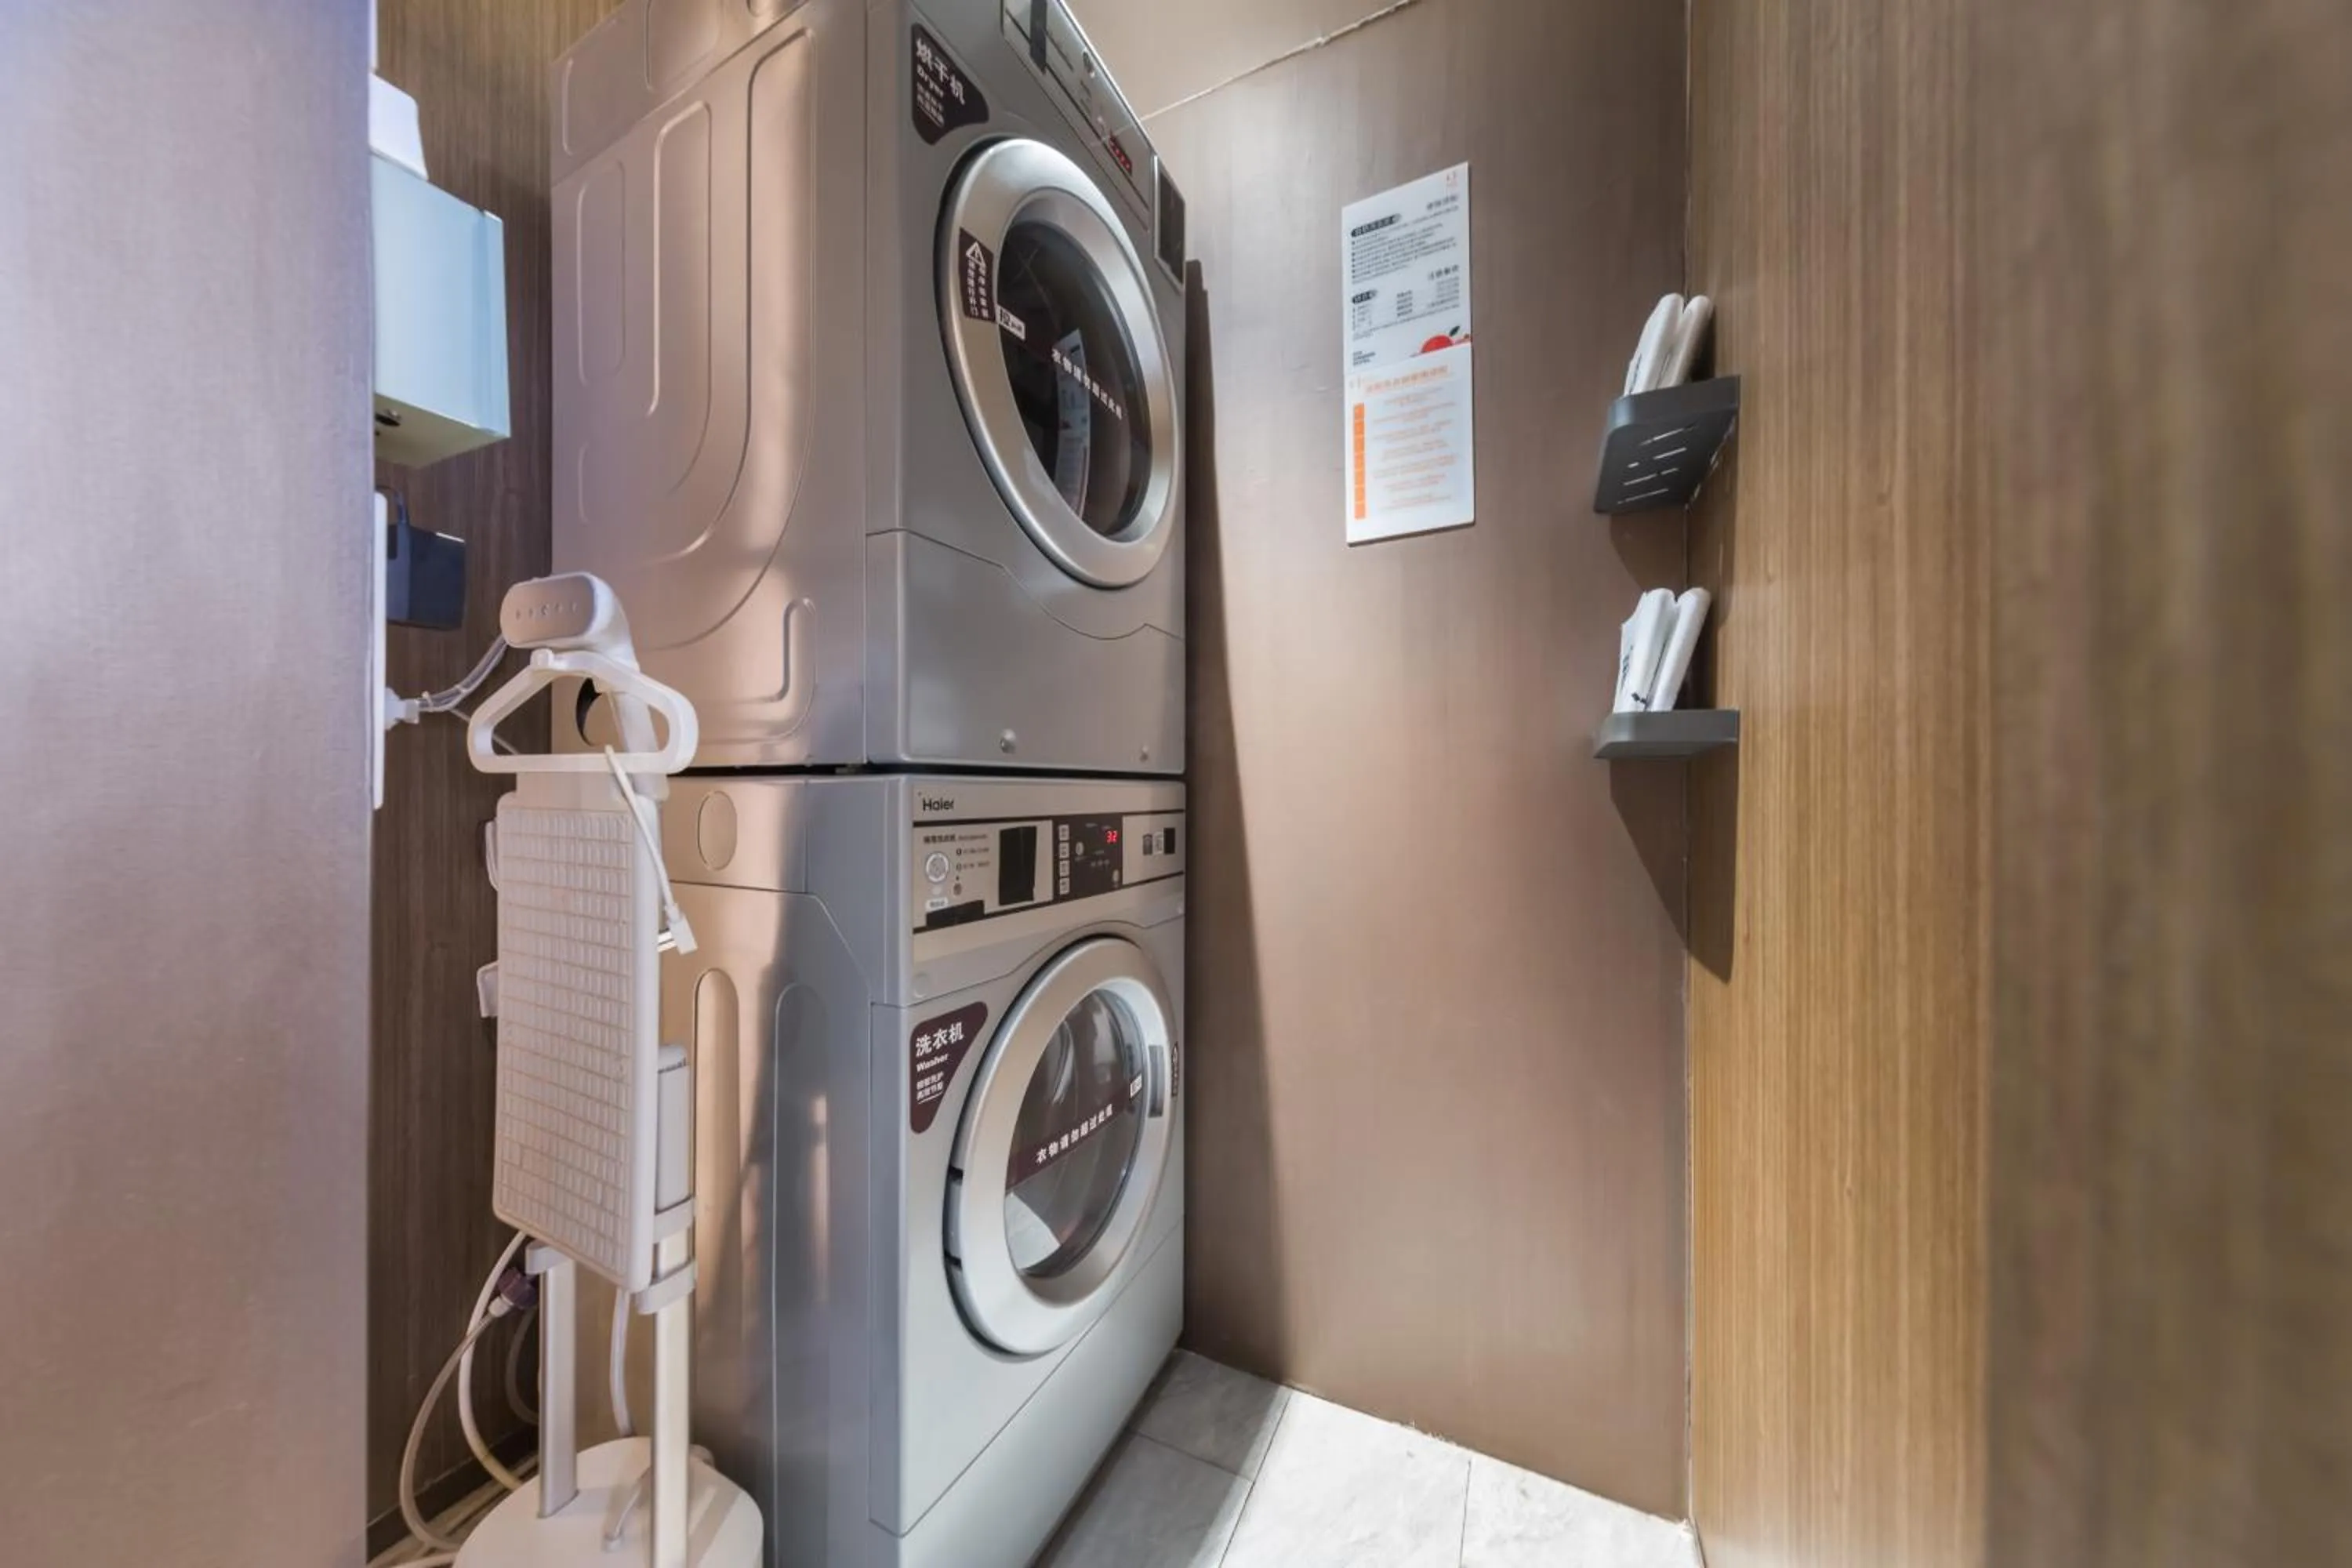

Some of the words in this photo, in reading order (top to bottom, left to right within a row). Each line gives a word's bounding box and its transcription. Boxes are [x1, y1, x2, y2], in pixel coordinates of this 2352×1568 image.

[923, 798, 954, 811] Haier
[916, 1022, 964, 1058] 洗衣机
[916, 1054, 948, 1073] Washer
